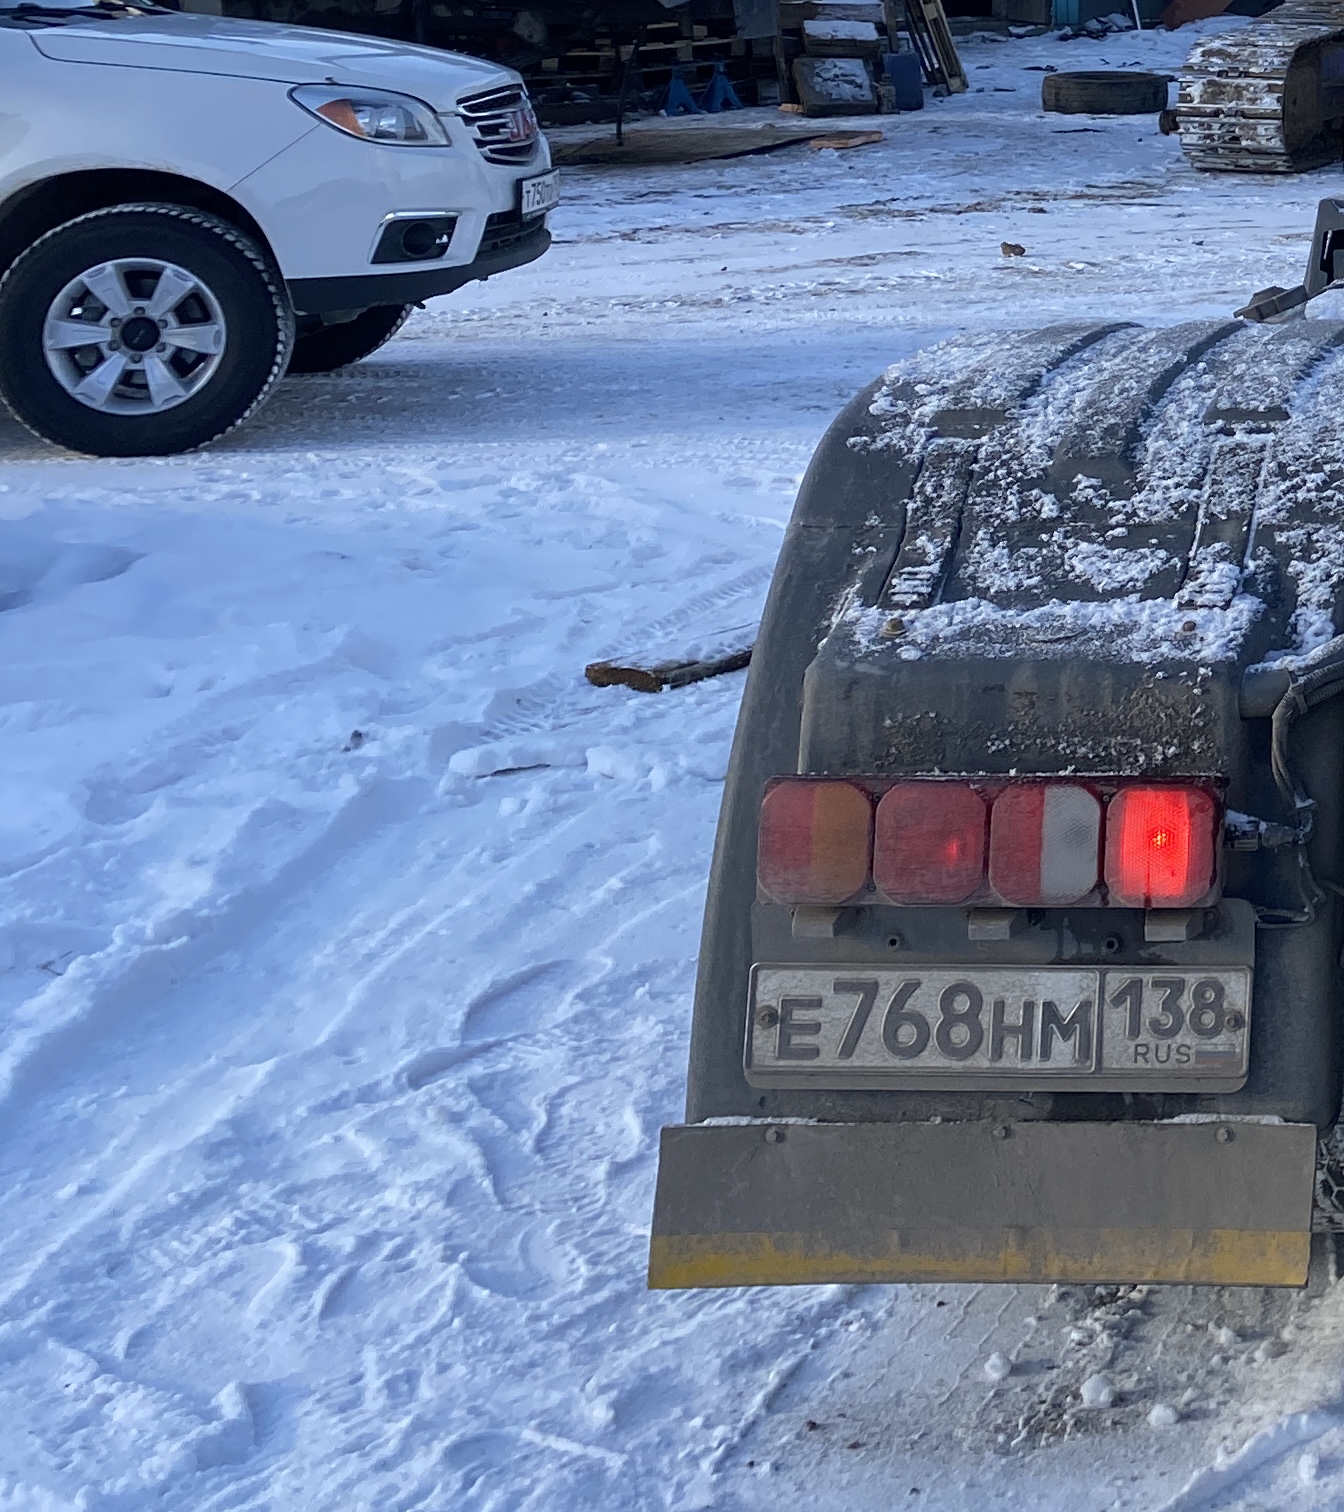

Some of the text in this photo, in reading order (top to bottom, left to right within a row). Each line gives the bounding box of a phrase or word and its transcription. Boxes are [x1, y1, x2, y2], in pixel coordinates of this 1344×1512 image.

[775, 977, 1226, 1062] Е768НМ 138
[1132, 1043, 1191, 1065] RUS
